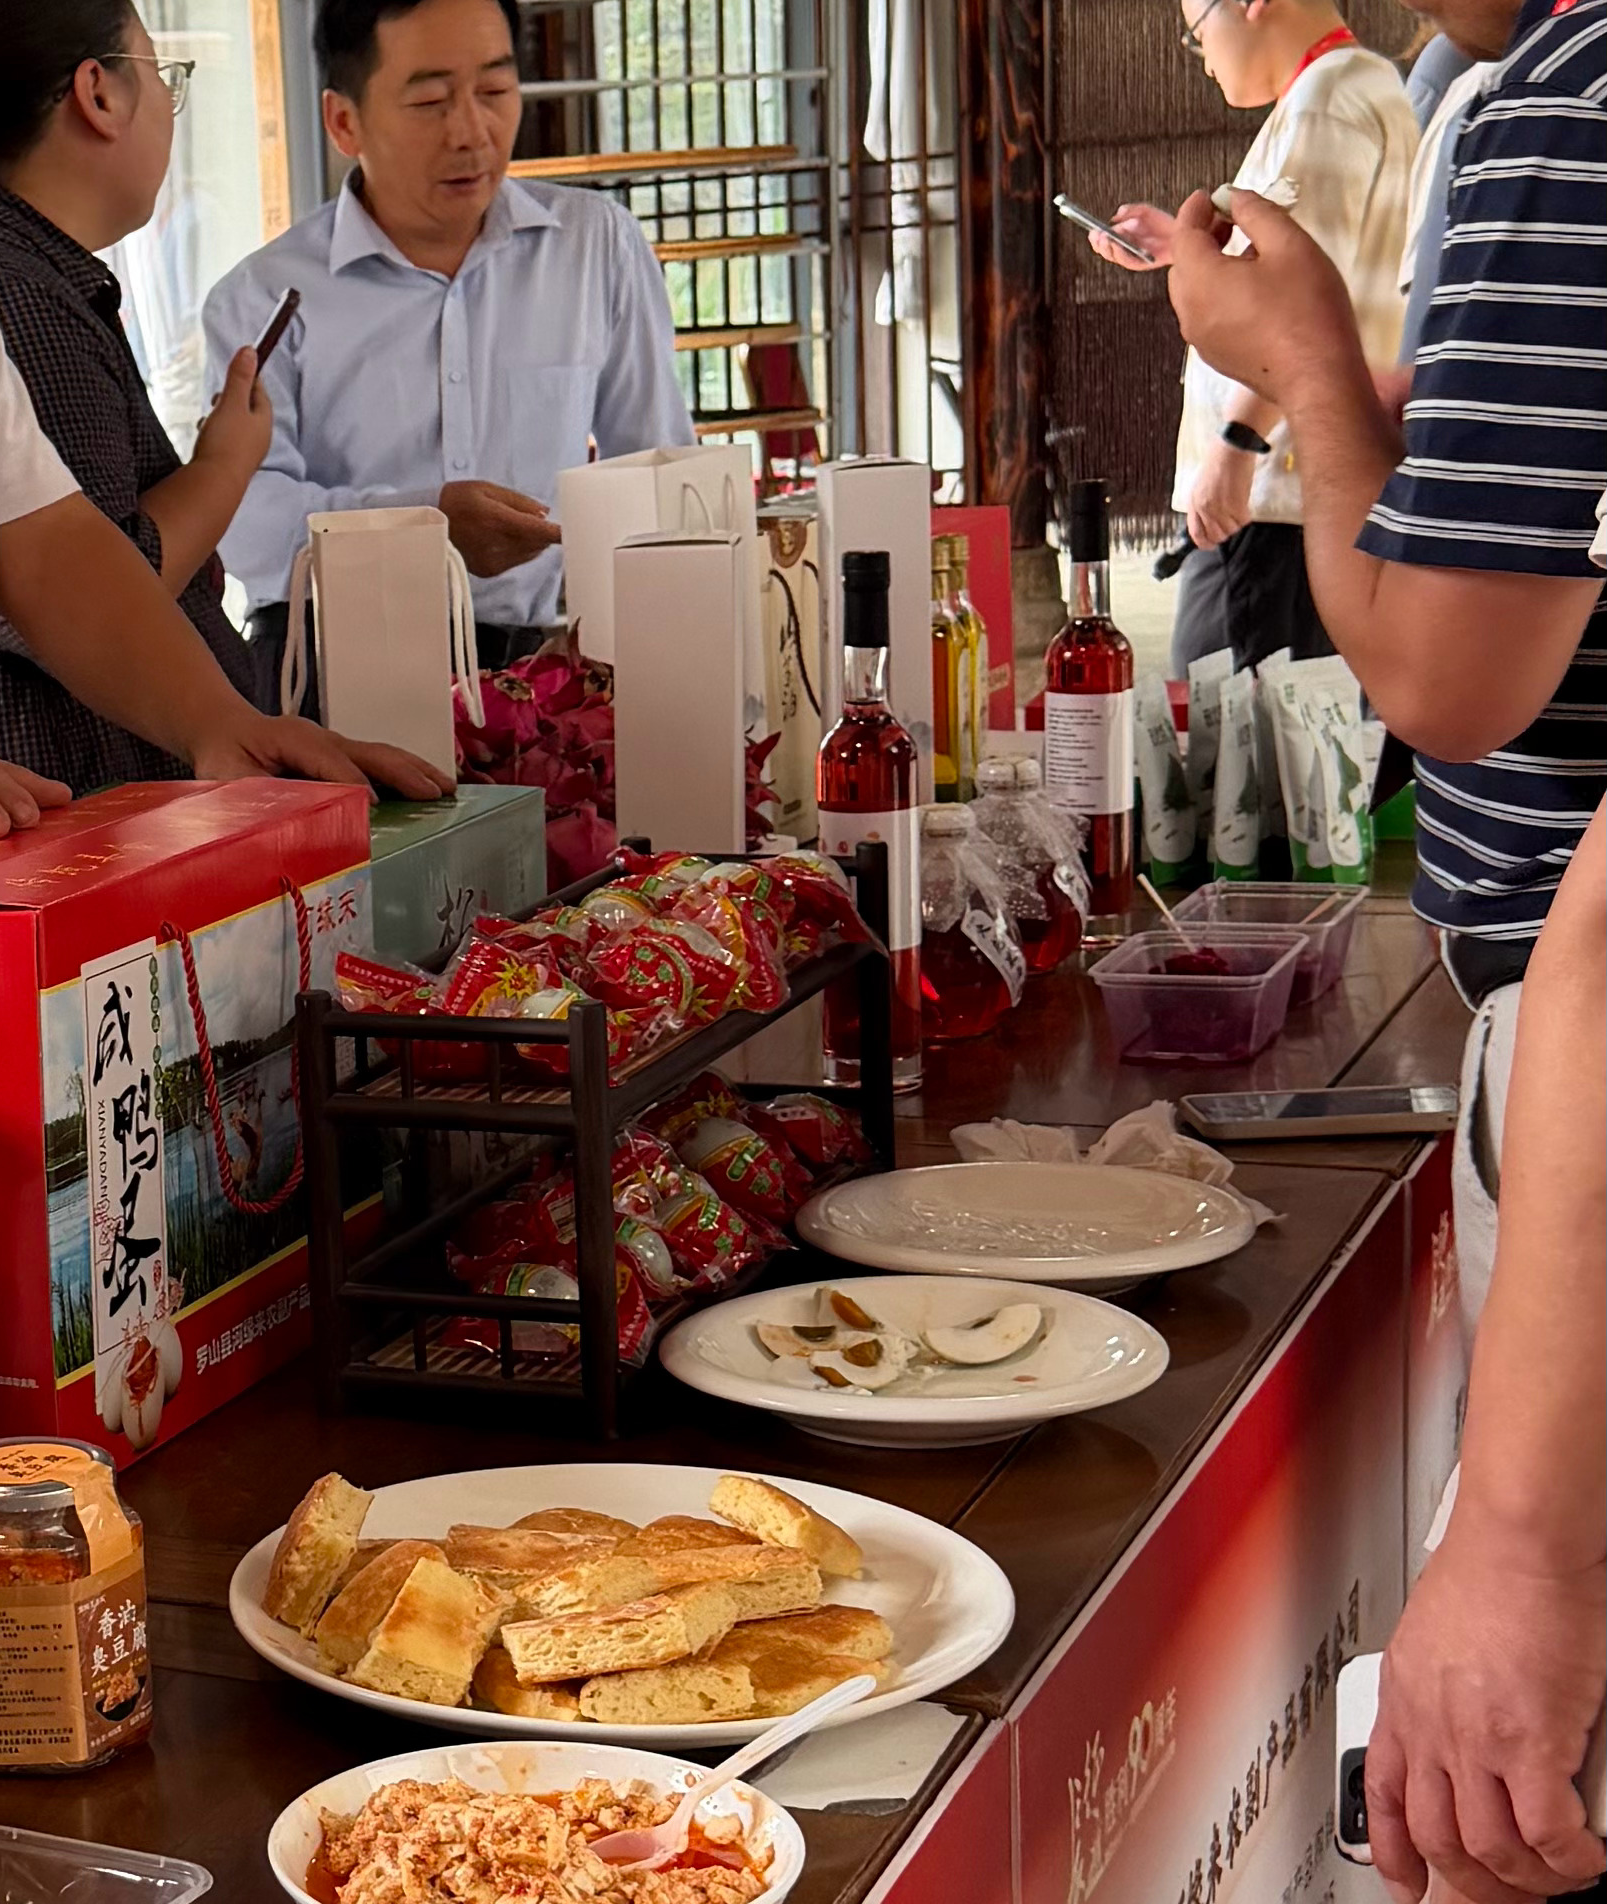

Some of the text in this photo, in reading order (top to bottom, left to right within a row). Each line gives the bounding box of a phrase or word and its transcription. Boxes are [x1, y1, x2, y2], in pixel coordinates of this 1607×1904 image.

[307, 888, 357, 933] 缘来
[93, 981, 162, 1318] 咸鸭蛋
[98, 1599, 136, 1640] 香油
